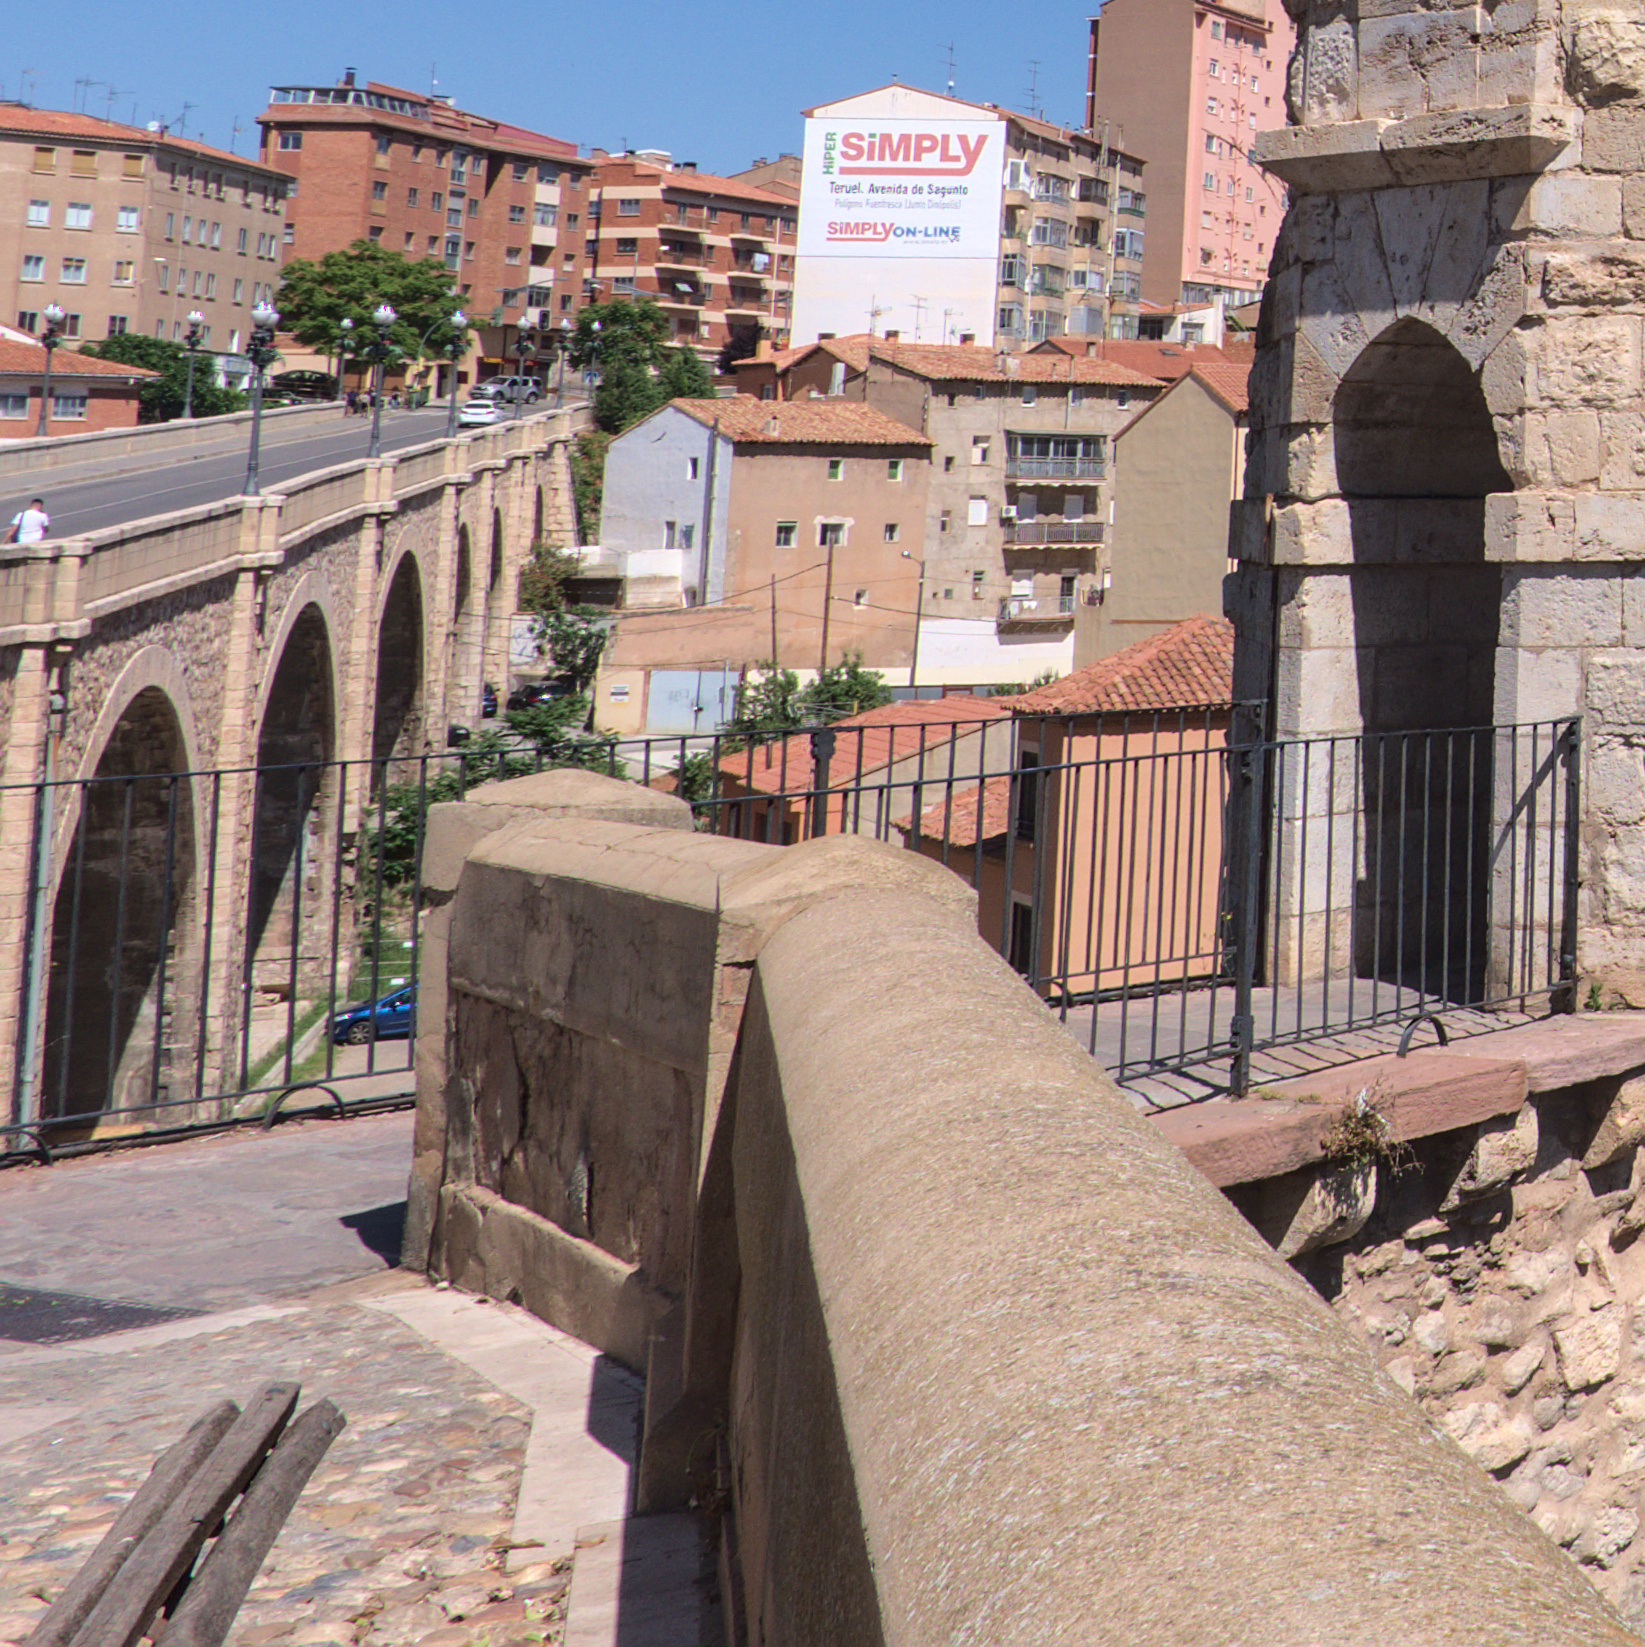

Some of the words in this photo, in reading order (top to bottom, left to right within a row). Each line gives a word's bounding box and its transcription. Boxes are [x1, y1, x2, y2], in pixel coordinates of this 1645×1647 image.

[829, 181, 864, 194] Teruel.
[868, 183, 908, 195] Avenida
[912, 184, 924, 195] de
[927, 183, 969, 198] Sagunto
